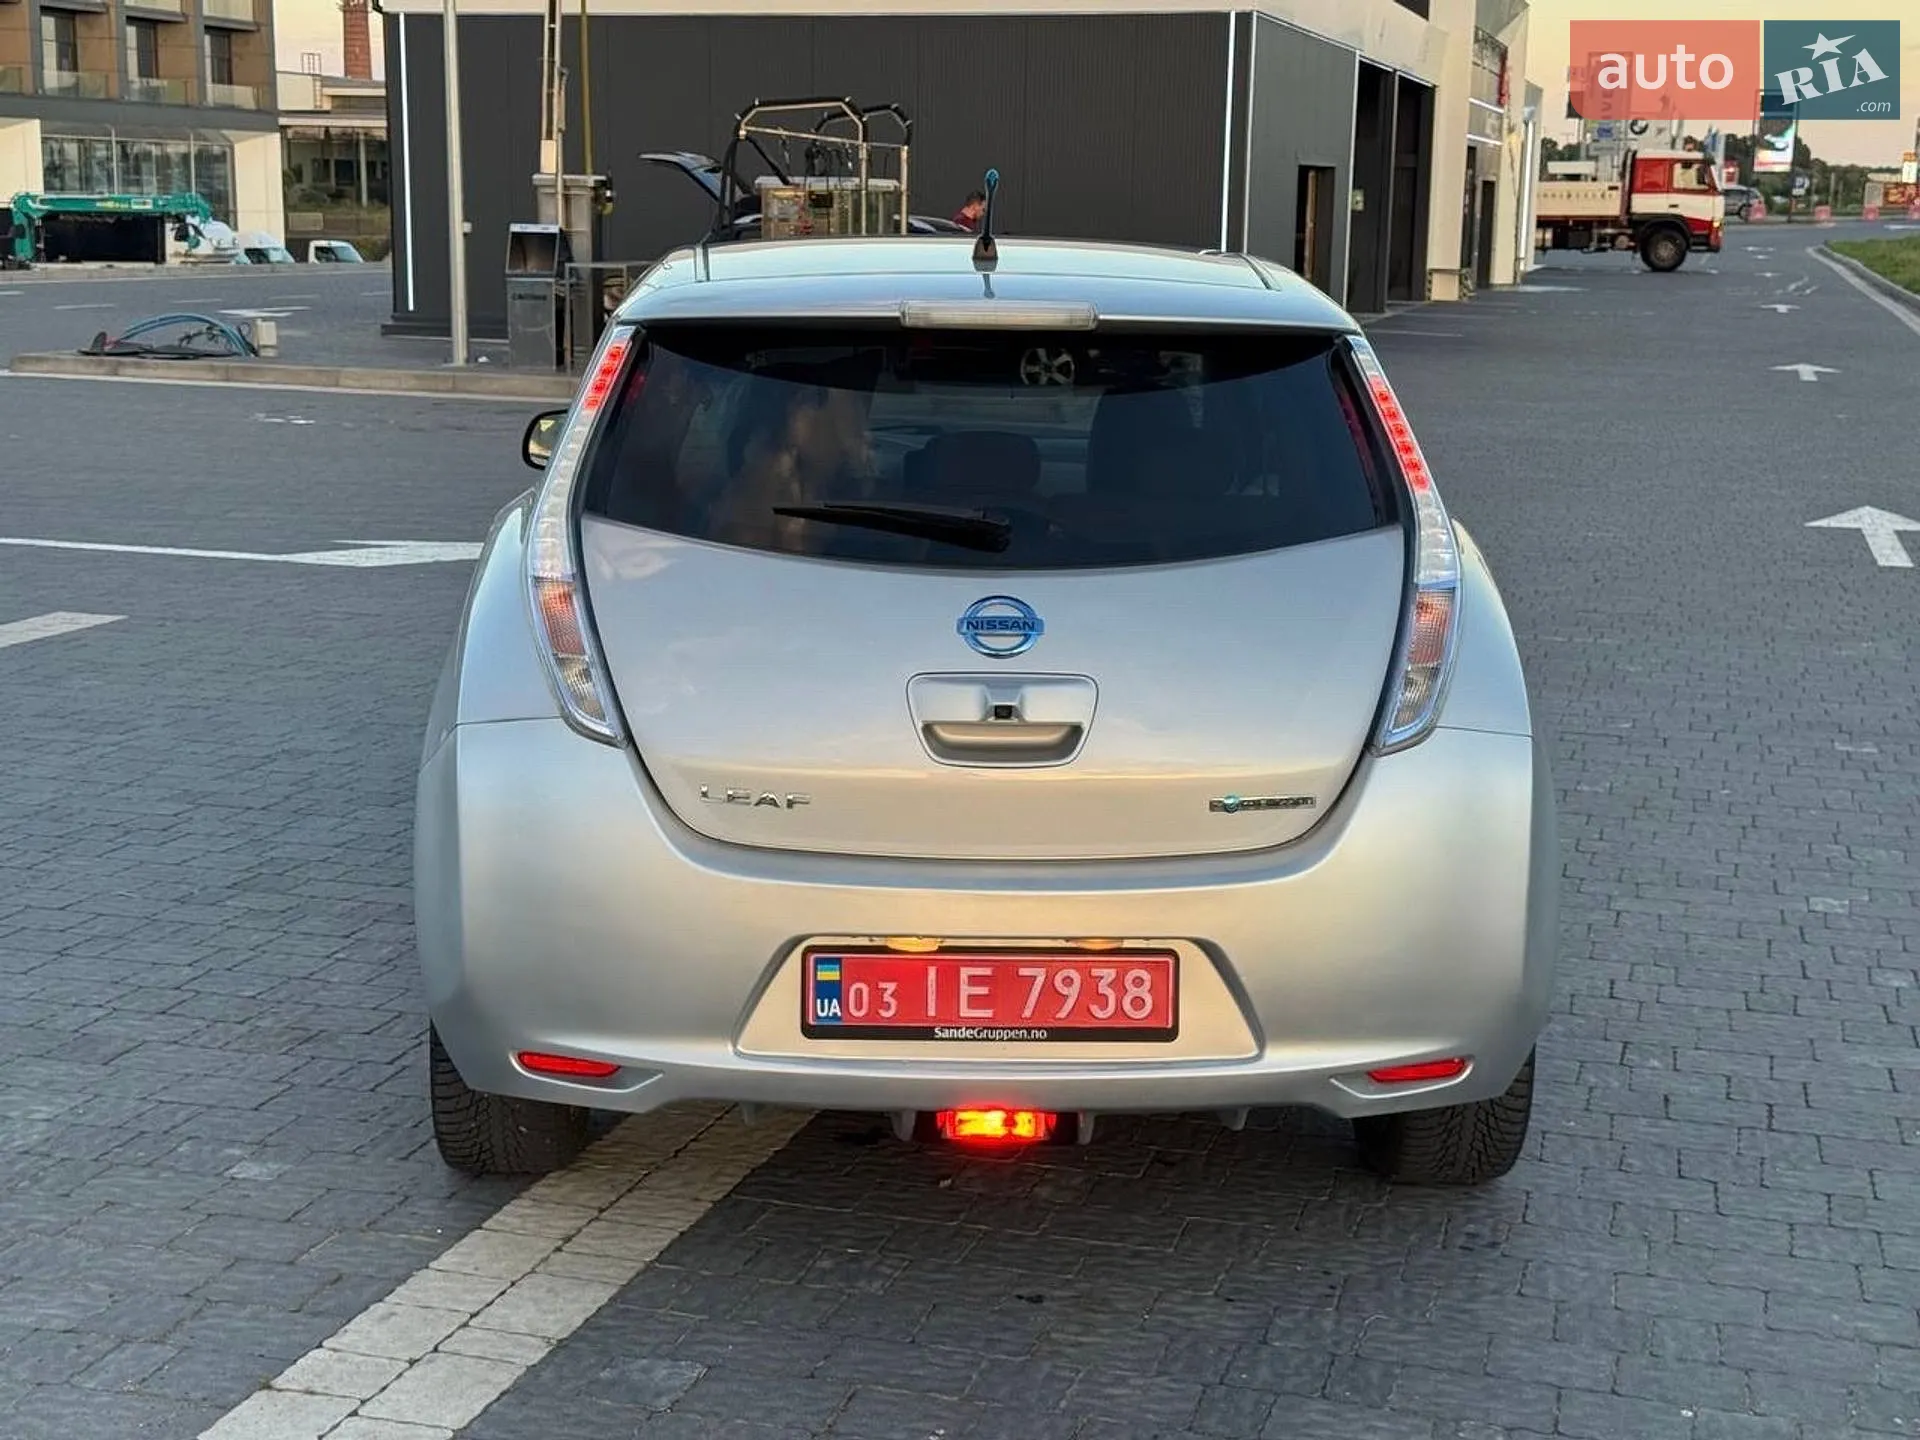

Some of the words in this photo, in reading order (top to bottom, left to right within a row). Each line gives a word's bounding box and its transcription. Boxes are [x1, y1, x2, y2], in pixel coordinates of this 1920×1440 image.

[966, 619, 1035, 631] NISSAN
[700, 784, 811, 809] LEAF
[850, 982, 899, 1018] 03
[926, 966, 995, 1018] IE
[1017, 967, 1154, 1020] 7938
[816, 998, 842, 1017] UA
[934, 1027, 1048, 1041] SandeGruppen.no
